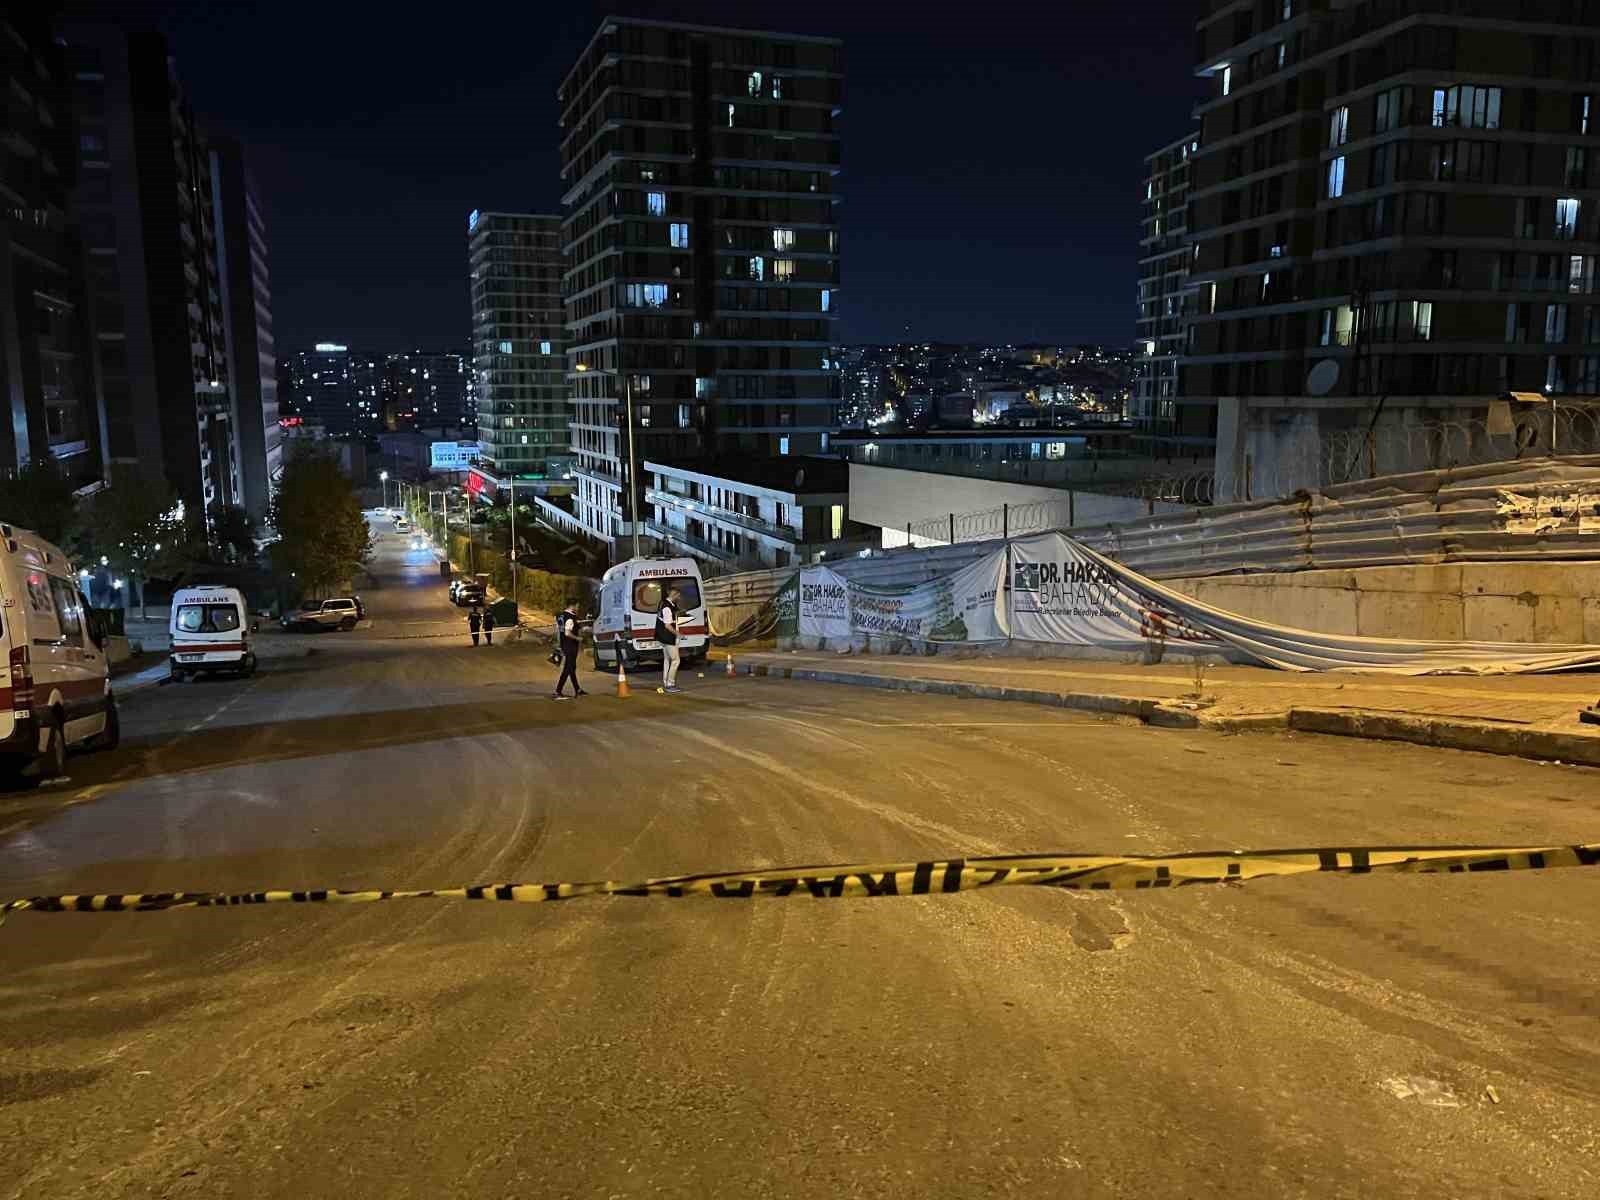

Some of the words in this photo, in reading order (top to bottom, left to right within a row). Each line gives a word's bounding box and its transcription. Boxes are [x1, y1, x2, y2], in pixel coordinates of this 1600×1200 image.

[639, 568, 689, 577] AMBULANS
[1039, 562, 1061, 583] DR.
[184, 596, 230, 604] AMBULANS
